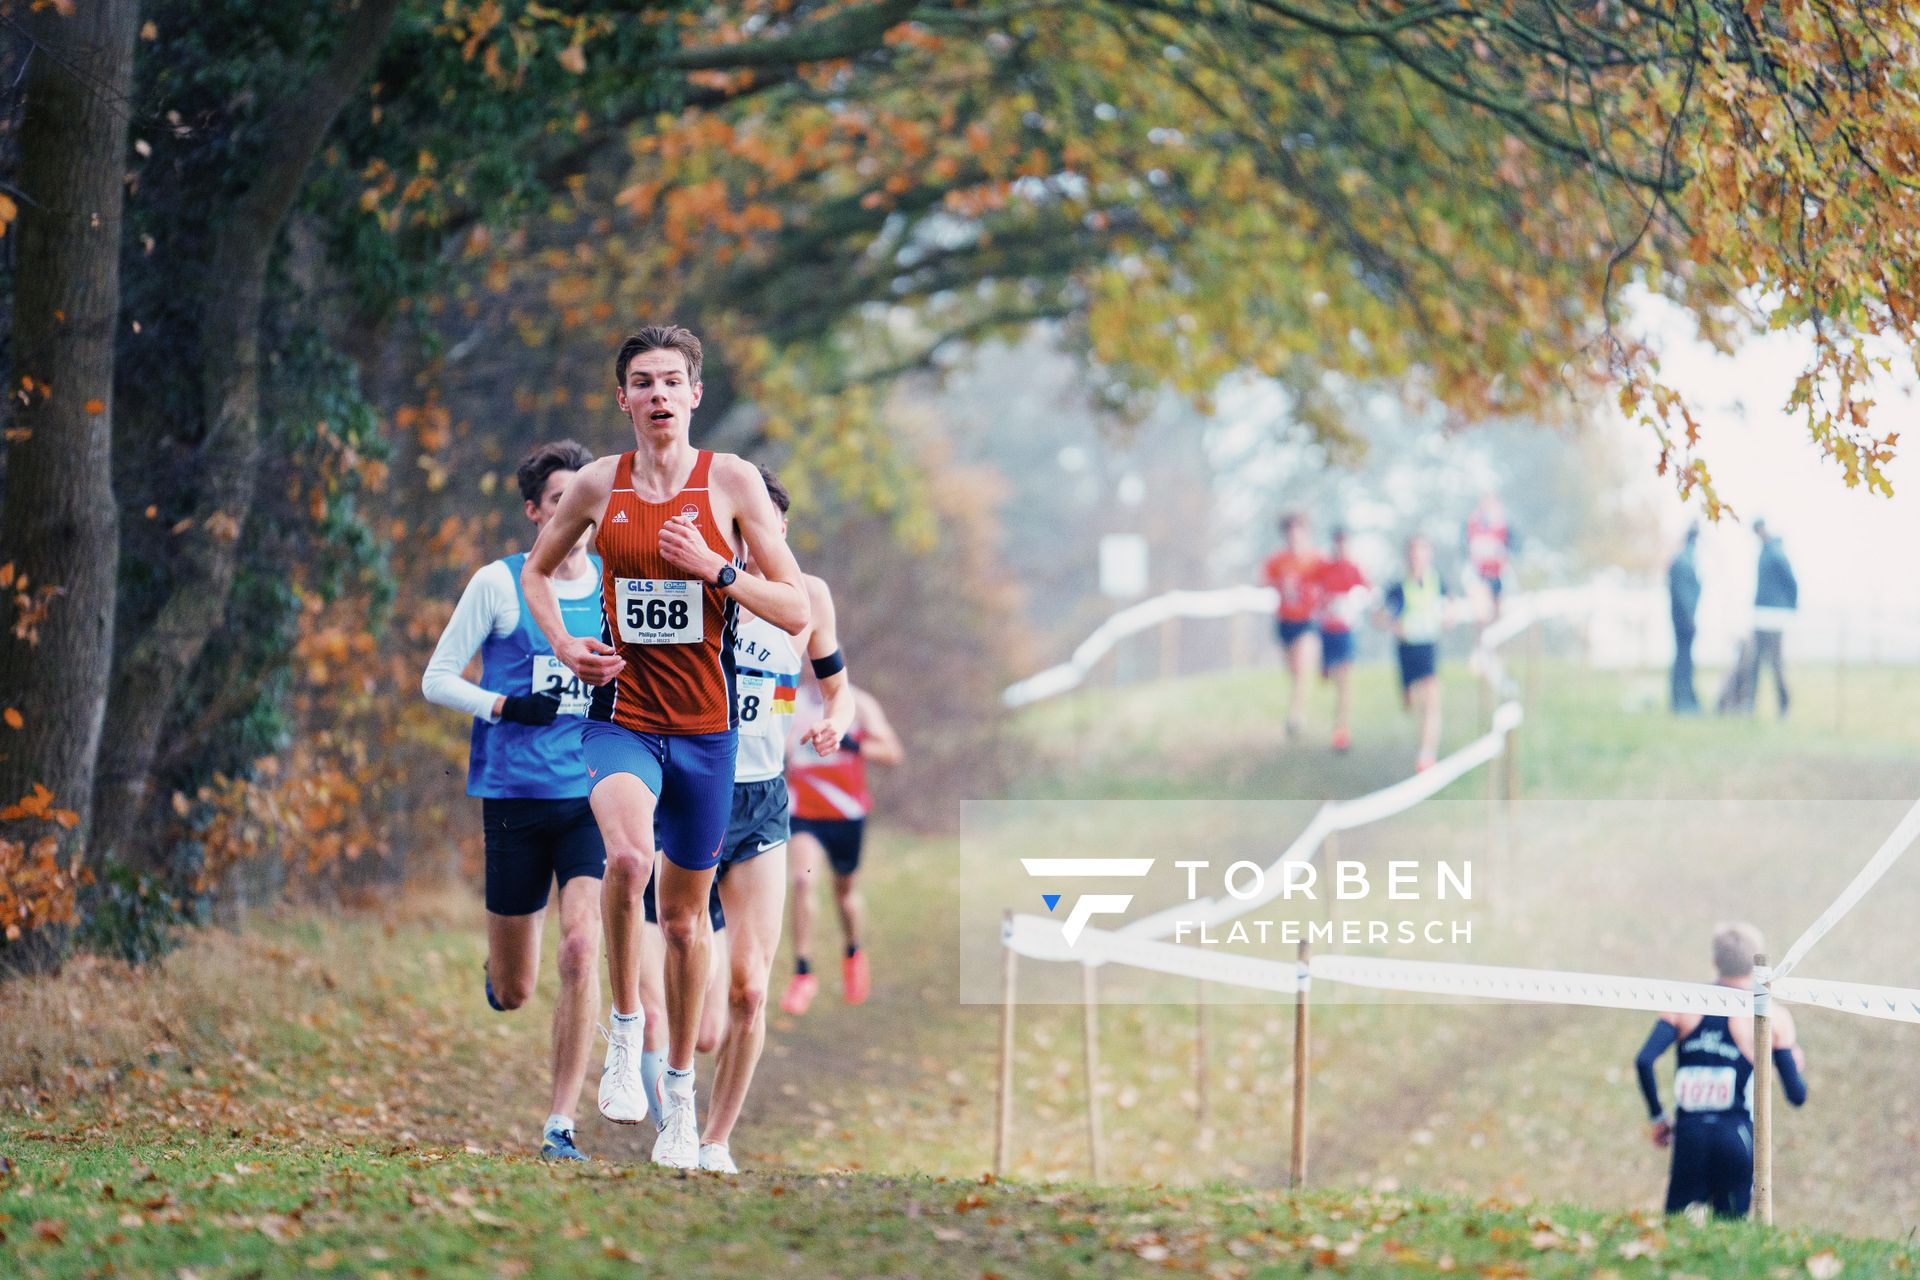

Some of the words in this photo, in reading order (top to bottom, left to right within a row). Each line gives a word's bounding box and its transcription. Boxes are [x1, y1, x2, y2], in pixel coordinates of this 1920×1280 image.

[627, 598, 689, 630] 568
[548, 658, 564, 668] GL
[738, 694, 760, 722] 8
